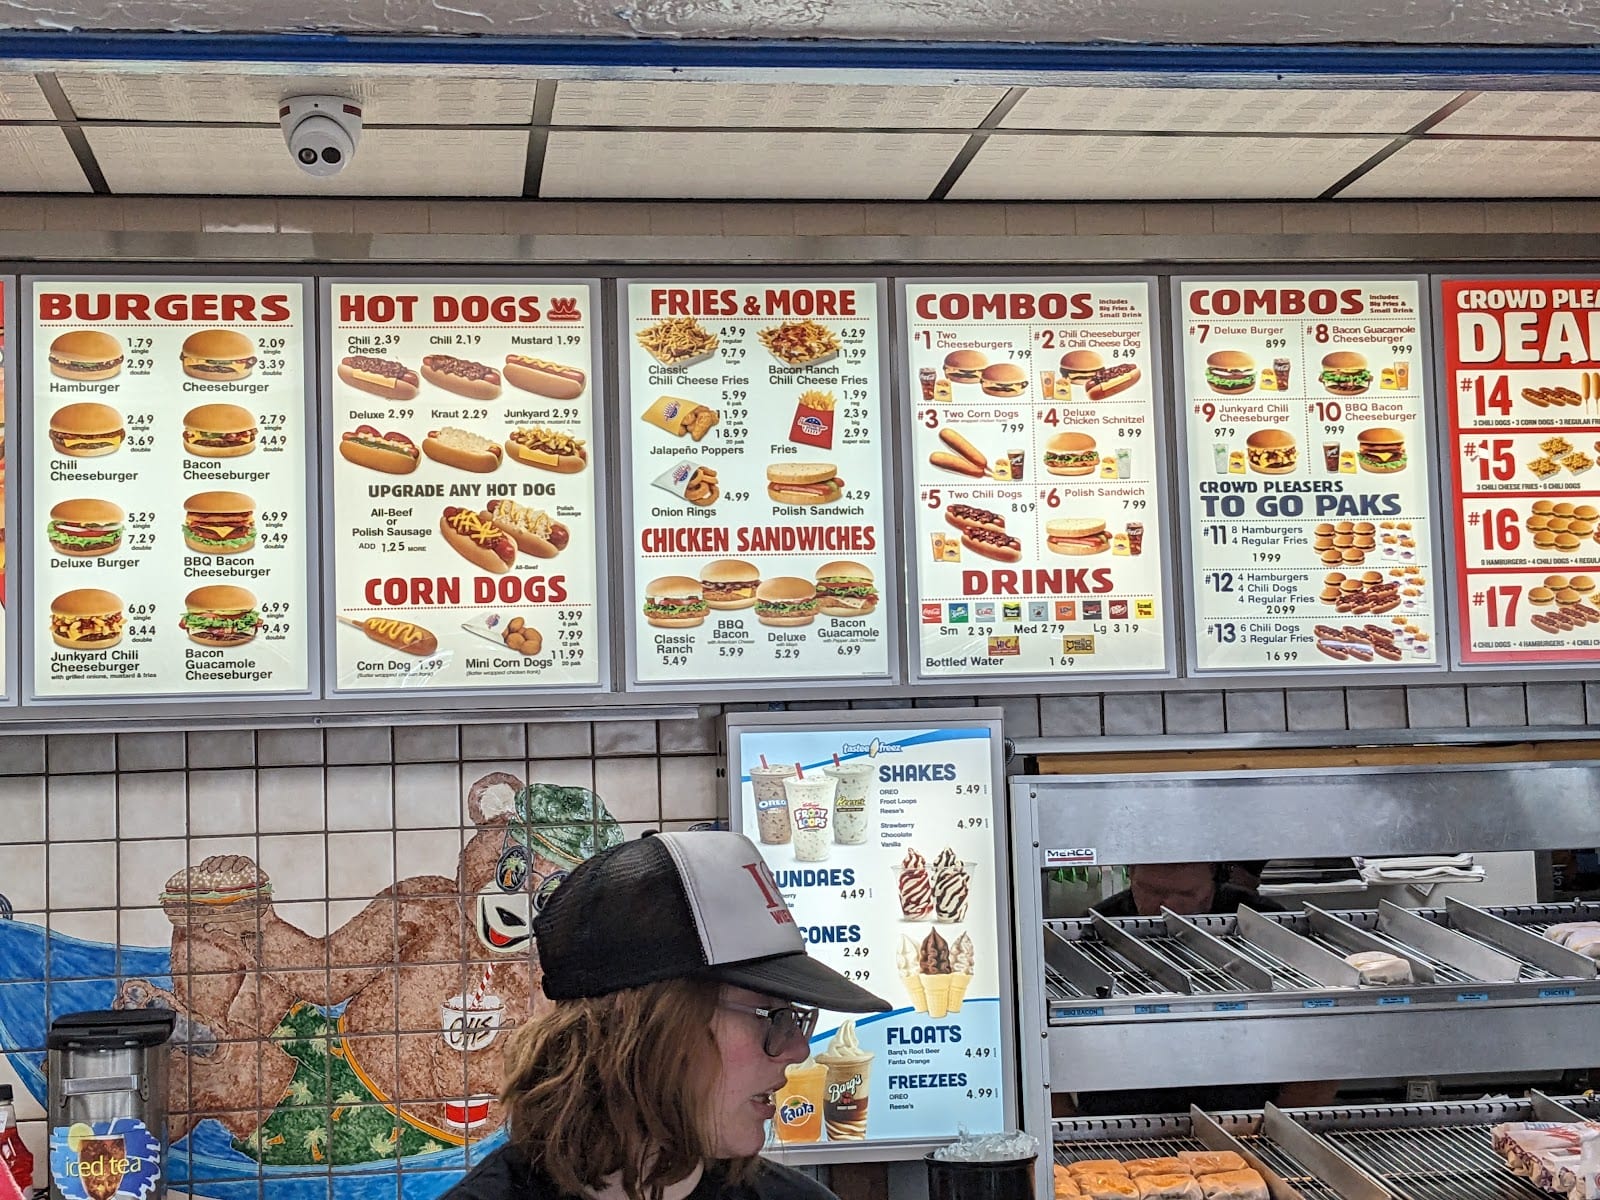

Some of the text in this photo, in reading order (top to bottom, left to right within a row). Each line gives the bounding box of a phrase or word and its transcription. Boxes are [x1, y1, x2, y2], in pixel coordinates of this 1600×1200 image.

[651, 290, 856, 316] FRIES & MORE
[1189, 289, 1365, 316] COMBOS
[1457, 289, 1600, 309] CROWD PLE
[40, 294, 290, 321] BURGERS
[340, 295, 541, 322] HOT DOGS
[916, 293, 1094, 320] COMBOS
[720, 326, 746, 338] 4.99
[1189, 324, 1284, 344] #7 Deluxe Burger
[1306, 323, 1416, 344] #8 Bacon Guacamole
[127, 338, 153, 348] 1.79
[259, 338, 286, 348] 2.09
[348, 335, 400, 346] Chili 2.39
[430, 335, 481, 345] Chili 2.19
[512, 336, 581, 345] Mustard 1.99
[914, 330, 957, 350] #1 Two
[937, 340, 1013, 350] Cheeseburgers
[1333, 335, 1404, 345] Cheeseburger
[348, 346, 387, 354] Cheese
[127, 359, 154, 370] 2.99
[259, 359, 286, 370] 3.39
[649, 365, 688, 375] Classic
[769, 365, 839, 375] Bacon Ranch
[649, 376, 749, 385] Chili Cheese Fries
[50, 382, 120, 394] Hamburger
[183, 382, 269, 393] Cheeseburger
[722, 391, 747, 400] 5.99
[1460, 375, 1513, 417] #14
[349, 409, 414, 419] Deluxe 2.99
[431, 409, 488, 419] Kraut 2.29
[504, 408, 579, 419] Junkyard 2.99
[918, 409, 939, 429] #3
[943, 410, 964, 418] Two
[967, 410, 991, 418] Corn
[994, 410, 1019, 419] Dogs
[1037, 408, 1096, 427] #4 Deluxe
[1063, 416, 1145, 425] Chicken Schnitzel
[650, 446, 744, 457] Jalapeño Poppers
[770, 445, 798, 454] Fries
[183, 460, 222, 469] Bacon
[183, 470, 270, 481] Cheeseburger
[368, 484, 556, 498] UPGRADE ANY HOT DOG
[1200, 480, 1344, 494] CROWD PLEASERS
[724, 492, 750, 502] 4.99
[846, 490, 871, 501] 4.29
[1200, 493, 1402, 517] TO GO PAKS
[371, 508, 413, 518] All-Beef
[651, 507, 717, 518] Onion Rings
[772, 506, 864, 516] Polish Sandwich
[386, 518, 397, 526] or
[352, 527, 432, 538] Polish Sausage
[1203, 525, 1227, 545] #11
[1241, 526, 1303, 536] Hamburgers
[1467, 508, 1521, 551] #16
[641, 526, 876, 553] CHICKEN SANDWICHES
[1241, 536, 1280, 547] Regular
[1283, 536, 1308, 545] Fries
[381, 542, 405, 553] 1.25
[51, 558, 140, 570] Deluxe Burger
[184, 557, 254, 567] BBQ Bacon
[184, 567, 271, 578] Cheeseburger
[962, 568, 1114, 596] DRINKS
[365, 576, 568, 605] CORN DOGS
[1472, 585, 1523, 627] #17
[558, 611, 583, 621] 3.99
[940, 627, 958, 636] Sm
[1014, 624, 1038, 634] Med
[1093, 623, 1107, 635] Lg
[654, 634, 696, 644] Classic
[768, 632, 806, 643] Deluxe
[185, 649, 224, 658] Bacon
[656, 644, 693, 654] Ranch
[774, 649, 800, 659] 5.29
[51, 650, 139, 662] Junkyard Chili
[662, 656, 687, 666] 5.49
[926, 656, 1004, 667] Bottled Water
[51, 662, 140, 674] Cheeseburger
[185, 659, 256, 669] Guacamole
[466, 658, 553, 669] Mini Corn Dogs
[185, 670, 273, 681] Cheeseburger
[842, 743, 870, 754] tastee
[878, 763, 956, 783] SHAKES
[955, 784, 980, 795] 5.49
[794, 807, 828, 820] FROOT
[797, 817, 828, 830] LOOPS
[957, 817, 983, 829] 4.99
[768, 868, 855, 888] UNDAES
[840, 889, 865, 899] 4.49
[798, 924, 861, 944] CONES
[843, 947, 870, 957] 2.49
[844, 970, 870, 980] 2.99
[886, 1025, 962, 1045] FLOATS
[964, 1048, 990, 1058] 4.49
[888, 1072, 968, 1090] FREEZEES
[829, 1073, 863, 1103] Barq's
[966, 1088, 992, 1100] 4.99
[780, 1102, 814, 1124] Fanta
[65, 1155, 142, 1178] iced tea
